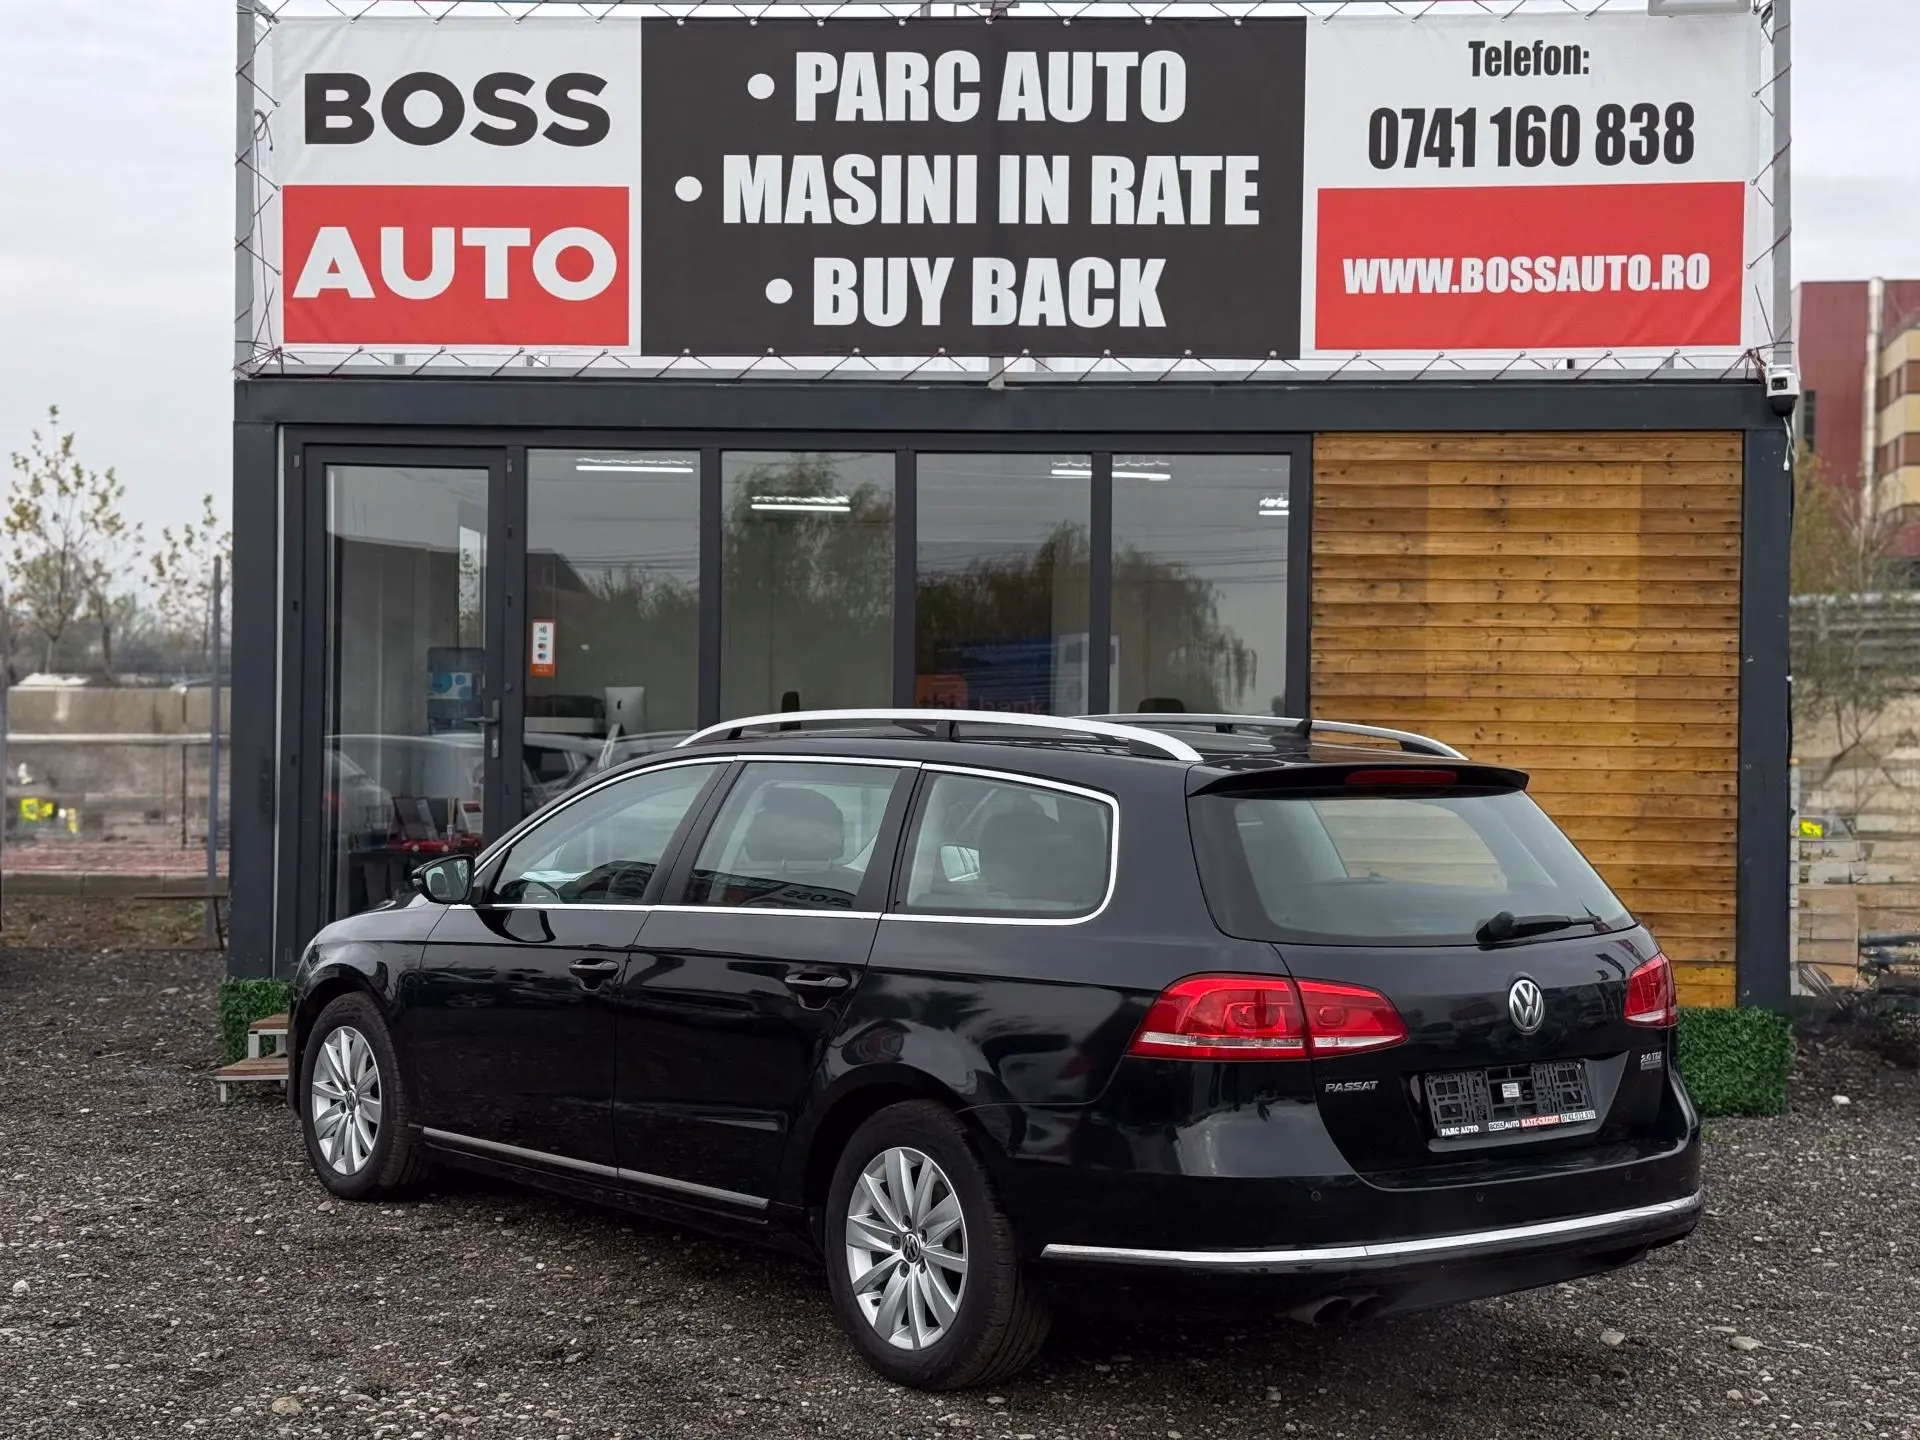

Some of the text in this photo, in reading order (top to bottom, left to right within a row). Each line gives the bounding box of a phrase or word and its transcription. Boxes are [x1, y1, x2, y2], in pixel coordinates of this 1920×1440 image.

[796, 50, 1186, 122] PARC AUTO
[1468, 40, 1590, 76] Telefon:
[305, 72, 610, 146] BOSS
[1369, 102, 1694, 169] 0741 160 838
[723, 154, 1259, 225] MASINI IN RATE
[293, 227, 616, 300] AUTO
[814, 257, 1166, 328] BUY BACK
[1343, 253, 1709, 293] WWW.BOSSAUTO.RO
[1325, 1080, 1379, 1092] PASSAT
[1441, 1124, 1479, 1136] PARC AUTO
